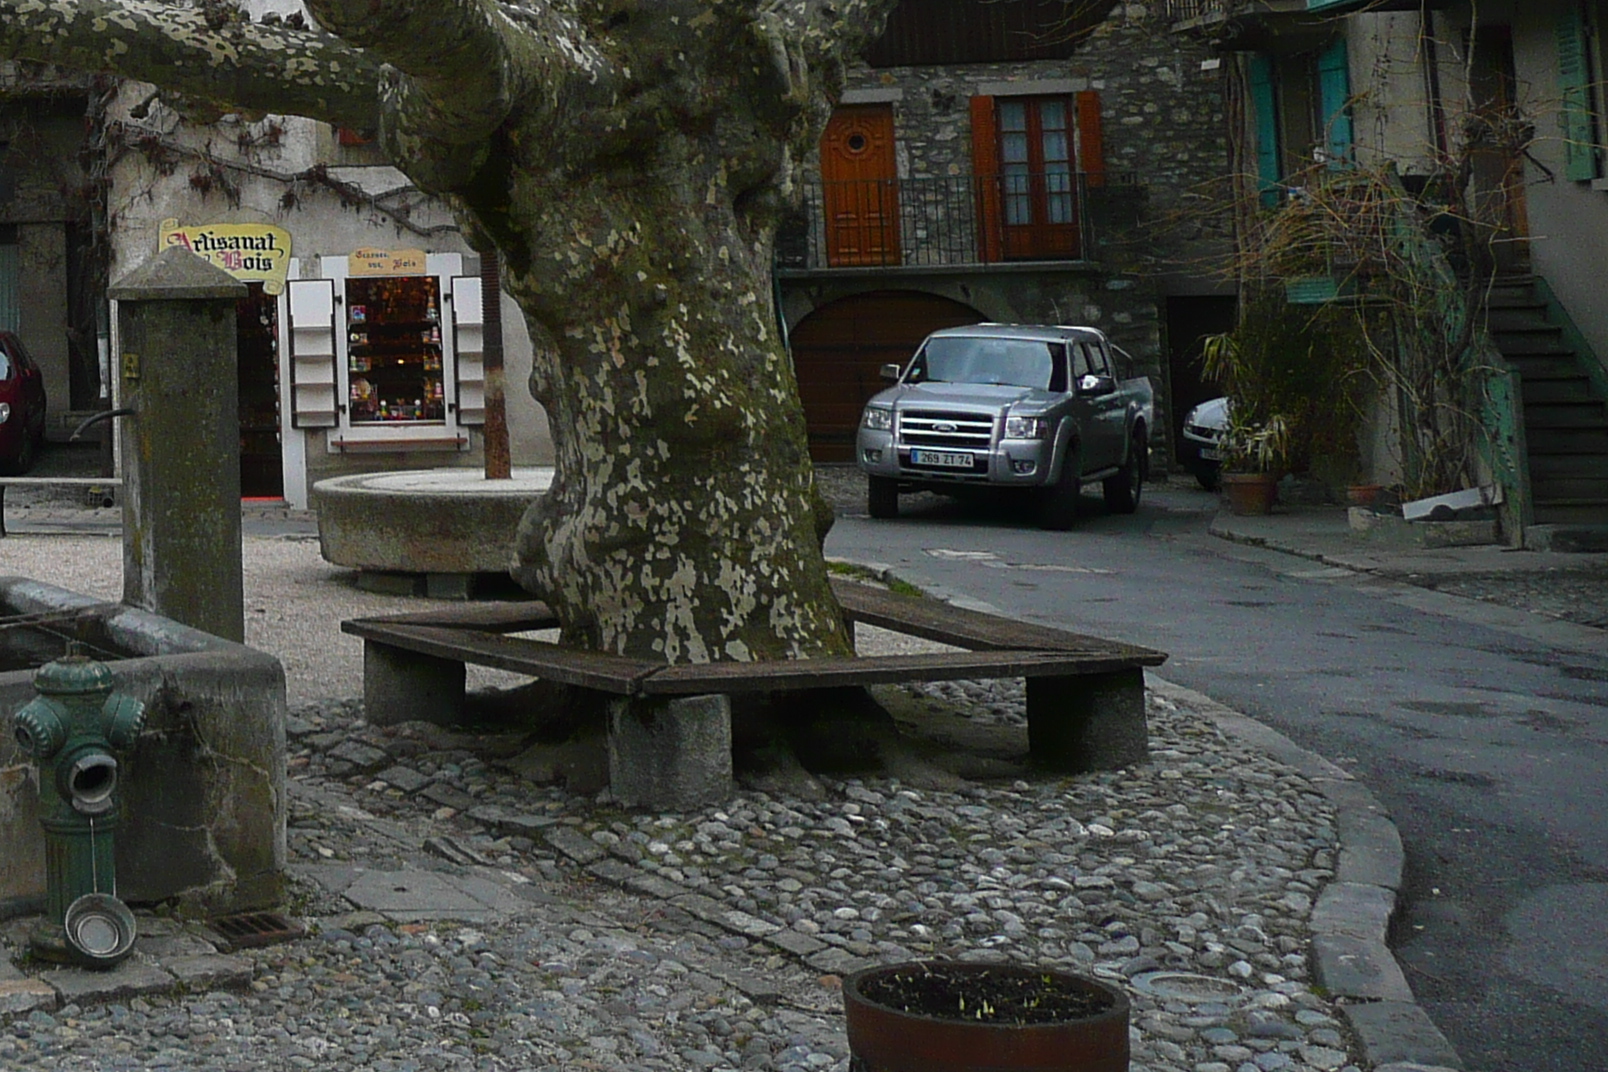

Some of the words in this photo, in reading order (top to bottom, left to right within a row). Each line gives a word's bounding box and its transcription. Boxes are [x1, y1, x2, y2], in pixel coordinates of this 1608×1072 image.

[167, 231, 284, 255] Artisanat
[216, 250, 273, 271] Bois
[921, 452, 940, 464] 269
[942, 454, 955, 465] ZT
[958, 455, 972, 466] 74
